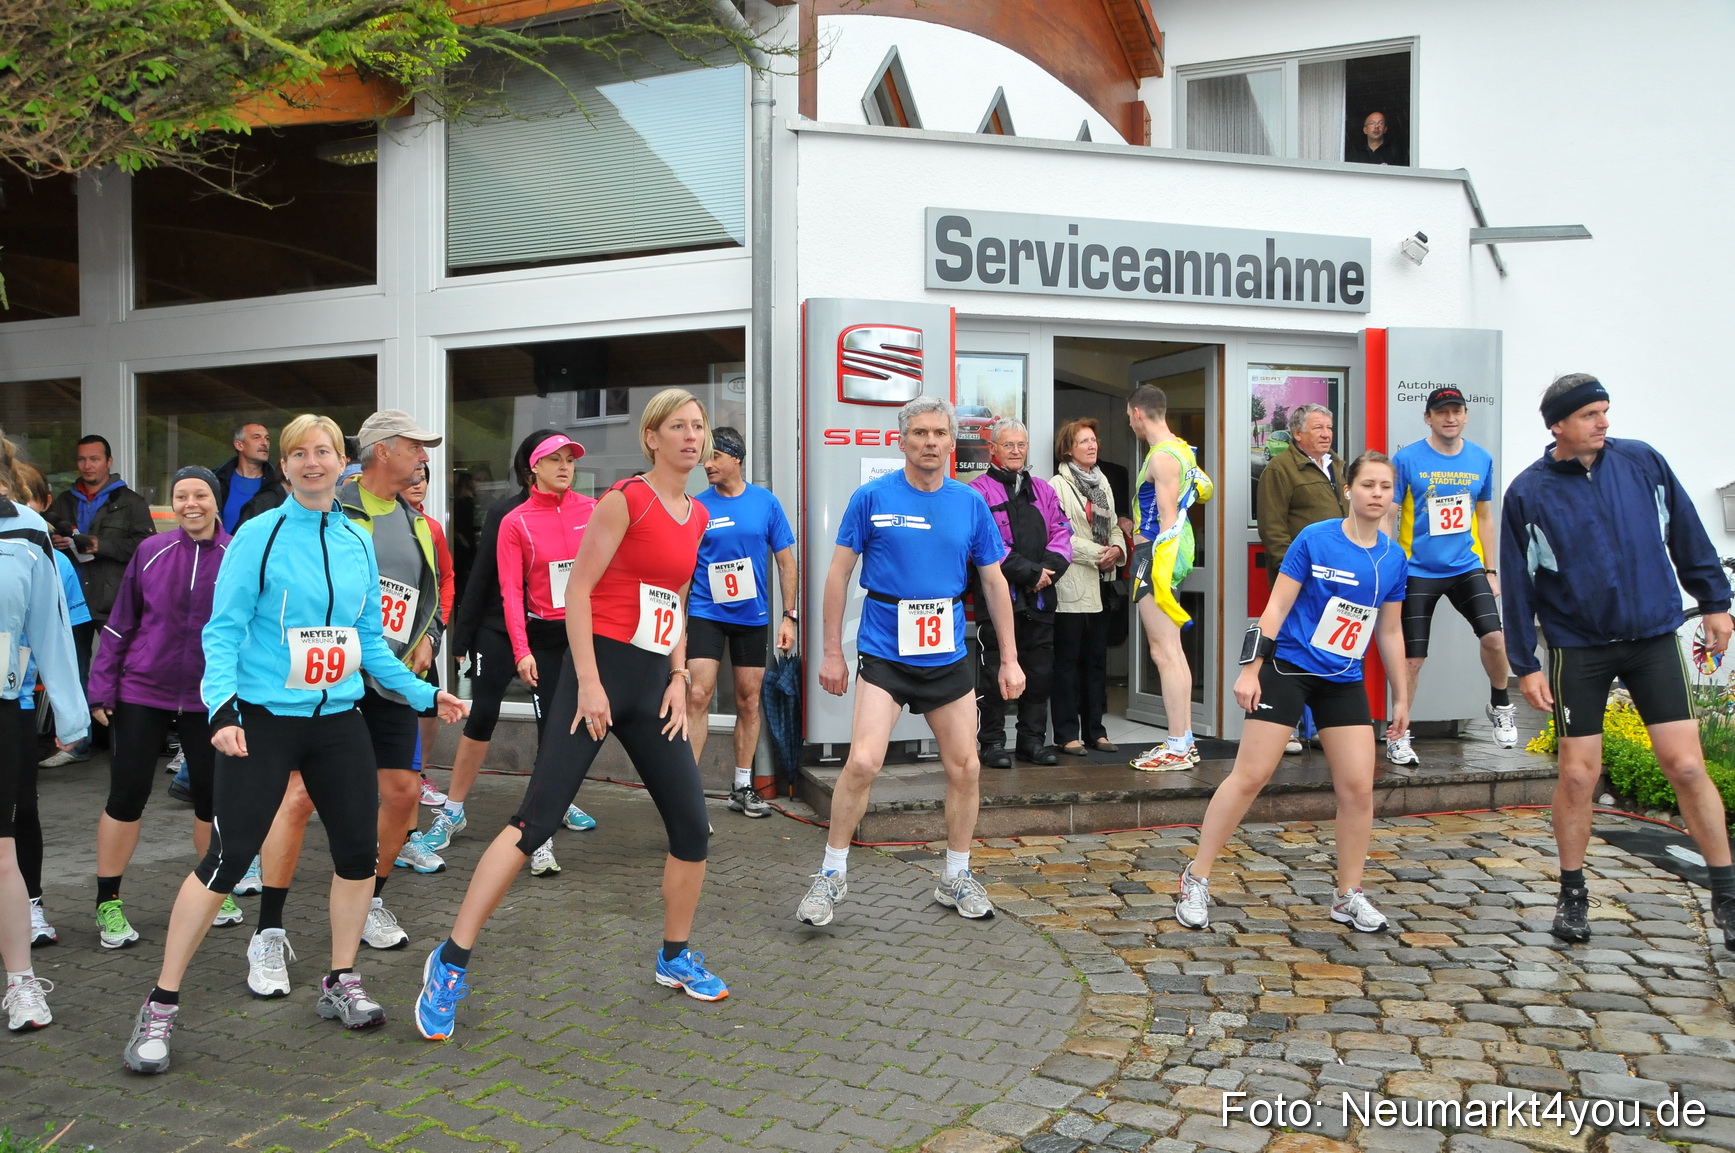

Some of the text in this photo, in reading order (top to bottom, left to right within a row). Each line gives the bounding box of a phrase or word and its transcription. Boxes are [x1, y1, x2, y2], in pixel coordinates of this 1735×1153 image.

[935, 215, 1365, 305] Serviceannahme
[1397, 380, 1457, 389] Autohaus
[1397, 393, 1427, 402] Gerh
[1465, 394, 1494, 405] Jänig
[824, 428, 900, 446] SEA
[959, 461, 975, 469] SEAT
[1419, 471, 1479, 481] 10. NEUMARKTER
[1429, 478, 1472, 486] STADTLAUF
[1440, 506, 1463, 530] 32
[380, 579, 405, 592] MEYER
[724, 573, 738, 597] 9
[649, 588, 671, 601] MEYER
[381, 595, 407, 632] 33
[1337, 602, 1364, 615] MEYER
[300, 630, 334, 638] MEYER
[654, 607, 674, 647] 12
[916, 616, 941, 647] 13
[1328, 615, 1362, 651] 76
[305, 646, 345, 684] 69
